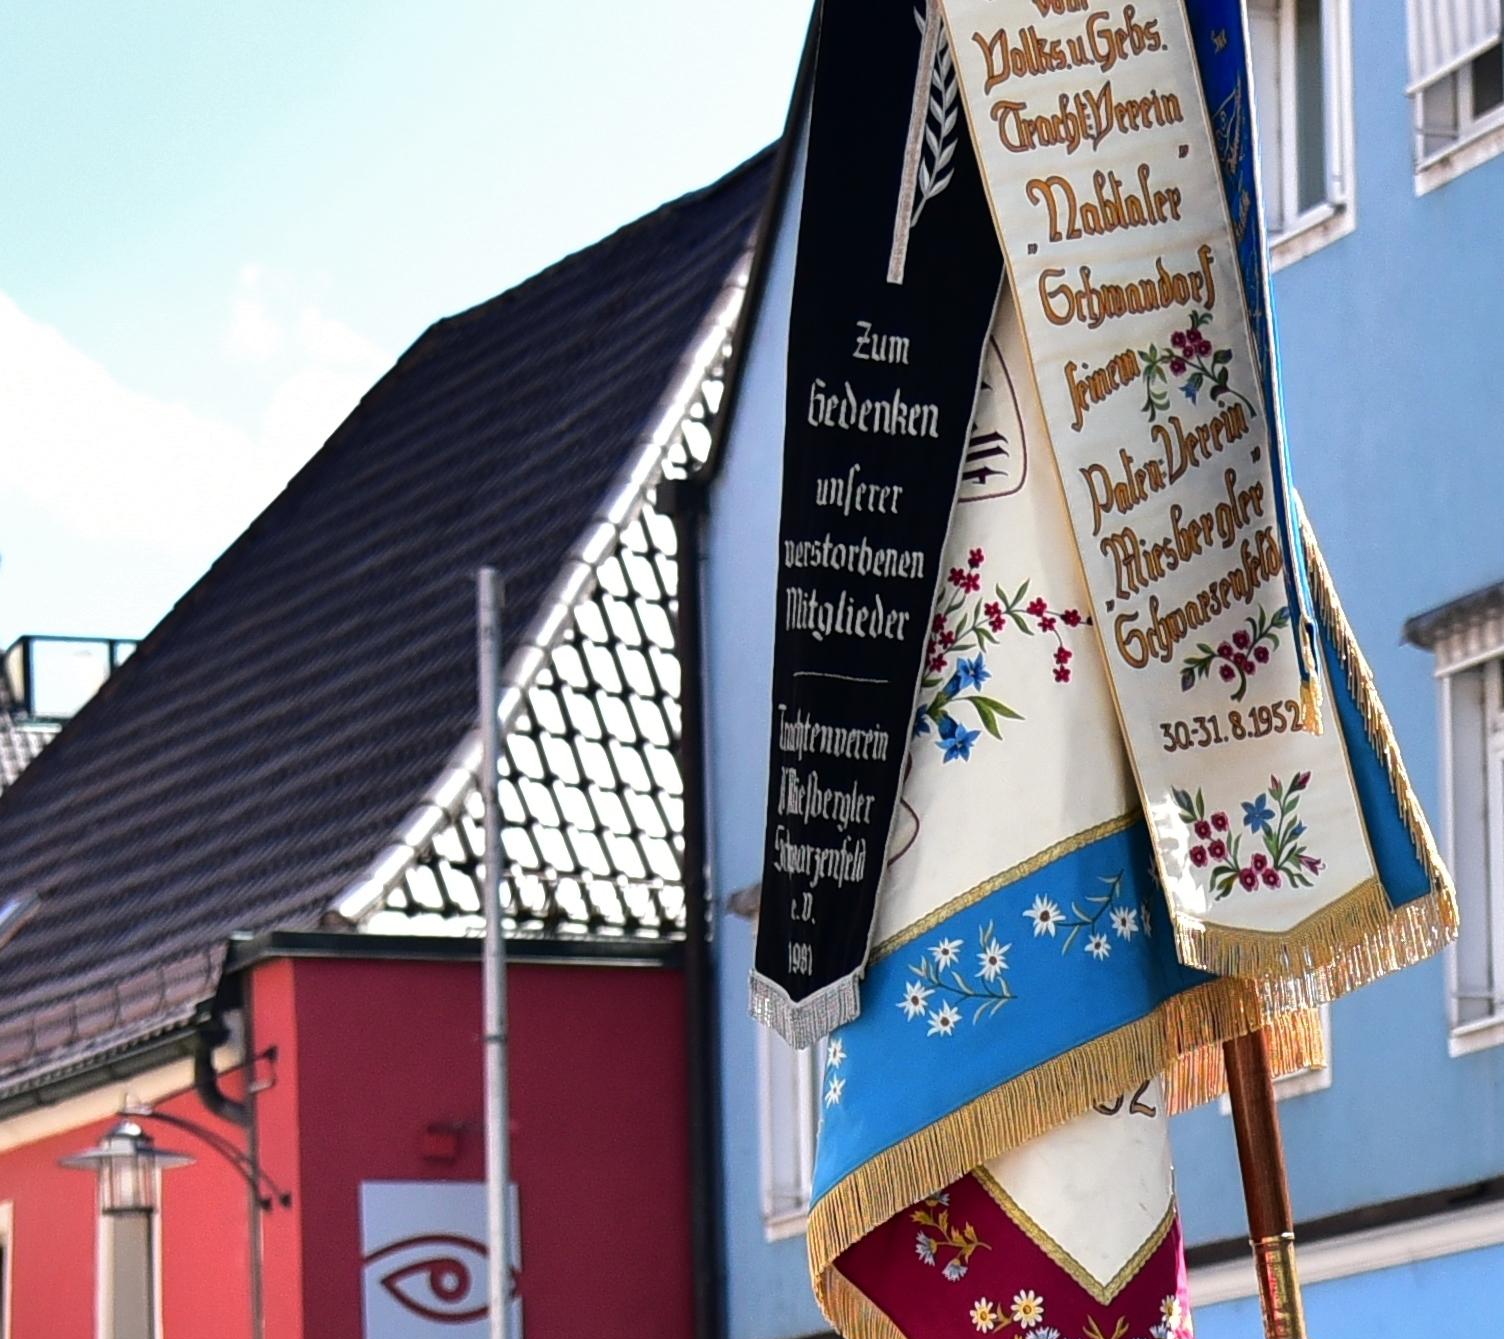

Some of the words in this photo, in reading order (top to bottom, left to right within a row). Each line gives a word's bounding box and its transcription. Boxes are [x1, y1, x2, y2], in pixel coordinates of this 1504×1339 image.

[1039, 245, 1216, 329] Schwandorf
[852, 320, 910, 365] Zum
[808, 377, 939, 438] Gedenken
[784, 532, 924, 579] verstorbenen
[785, 586, 910, 642] Mitglieder
[1114, 525, 1283, 669] Schwarzenfeld
[777, 703, 889, 762] Trachtenverein
[773, 824, 866, 888] Schwarzenfeld
[787, 940, 813, 976] 1981
